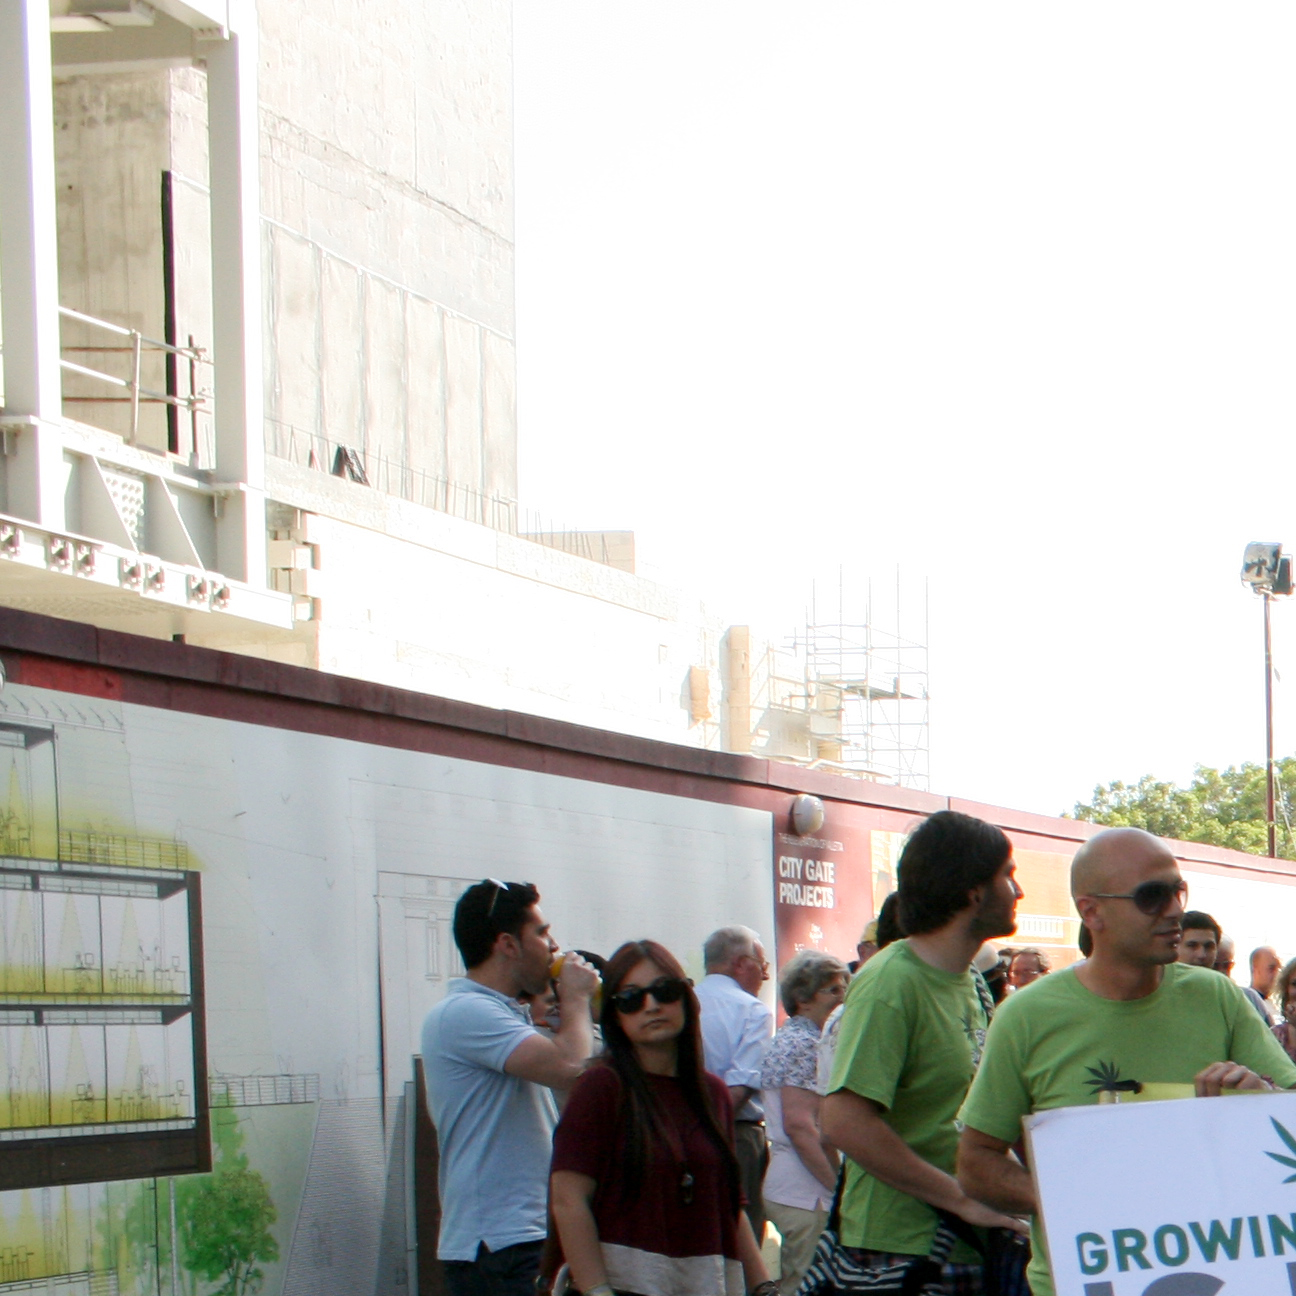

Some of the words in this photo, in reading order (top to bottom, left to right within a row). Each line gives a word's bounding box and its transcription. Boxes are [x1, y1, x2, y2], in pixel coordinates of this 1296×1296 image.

[779, 855, 803, 880] CITY
[805, 859, 835, 884] GATE
[779, 882, 835, 909] PROJECTS
